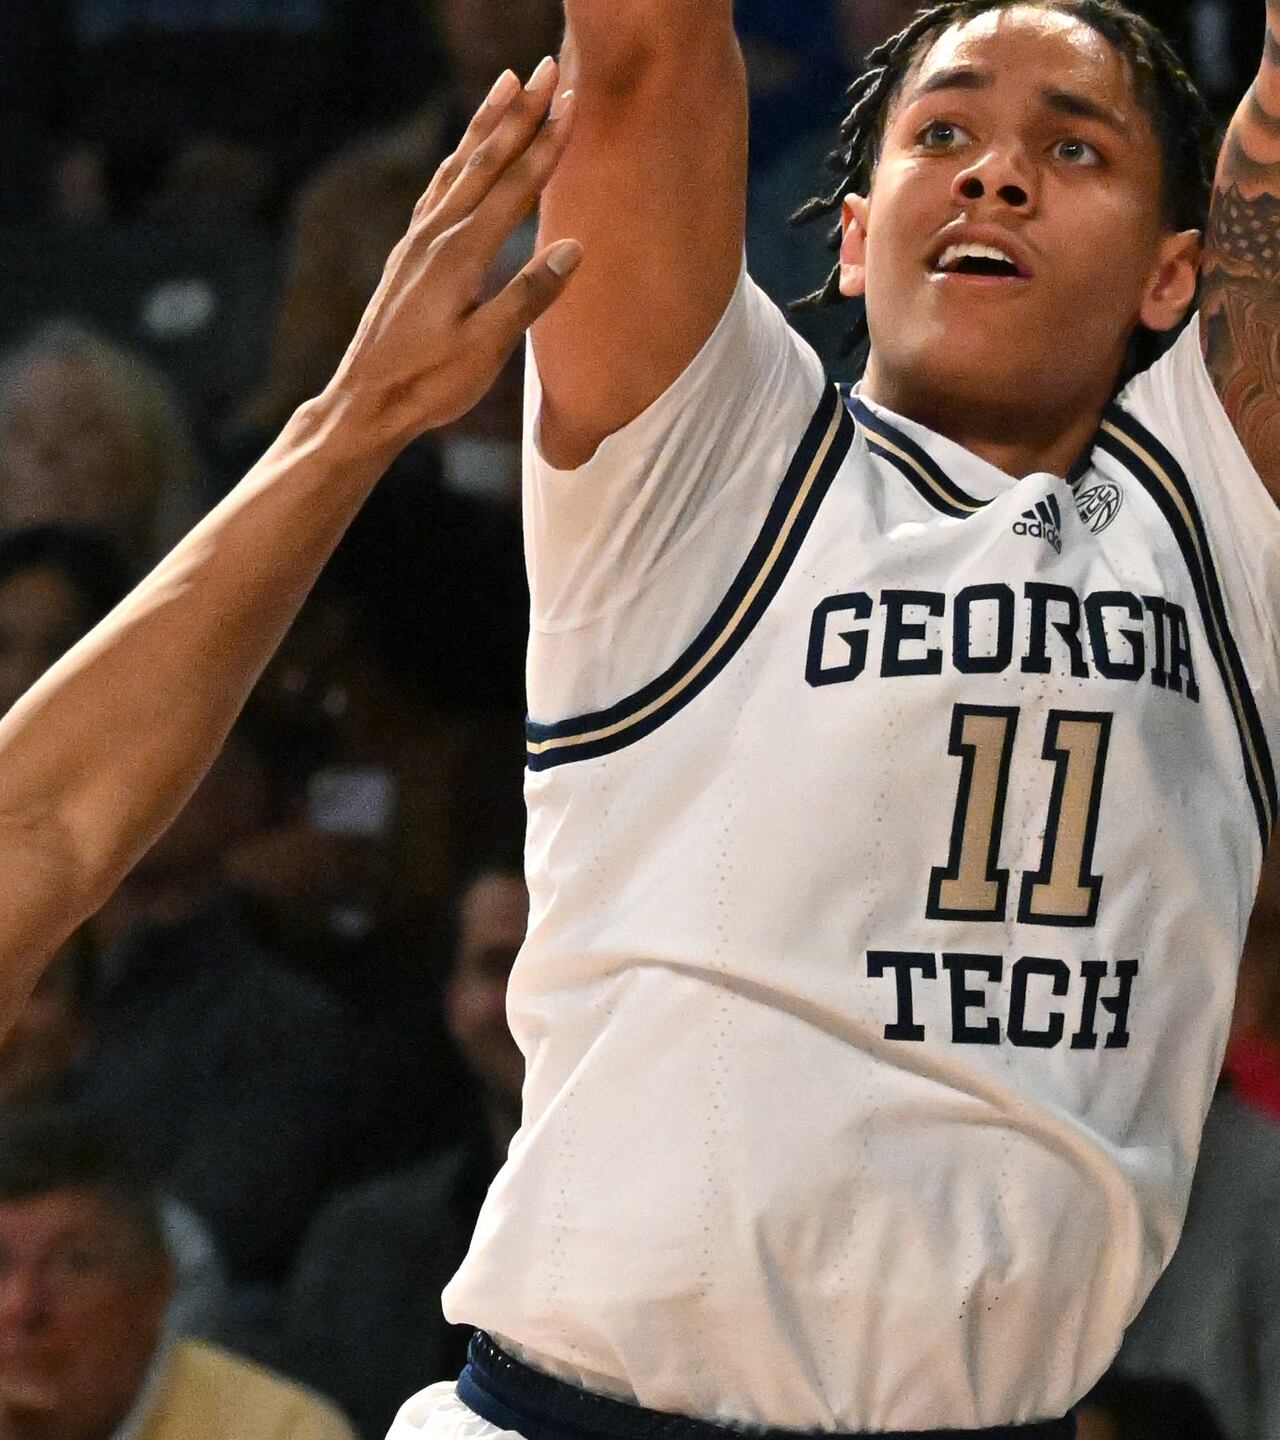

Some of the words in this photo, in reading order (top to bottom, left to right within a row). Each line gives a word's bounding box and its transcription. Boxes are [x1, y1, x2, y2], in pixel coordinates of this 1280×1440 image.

[804, 582, 1200, 703] GEORGIA
[925, 703, 1114, 927] 11
[866, 950, 1139, 1049] TECH
